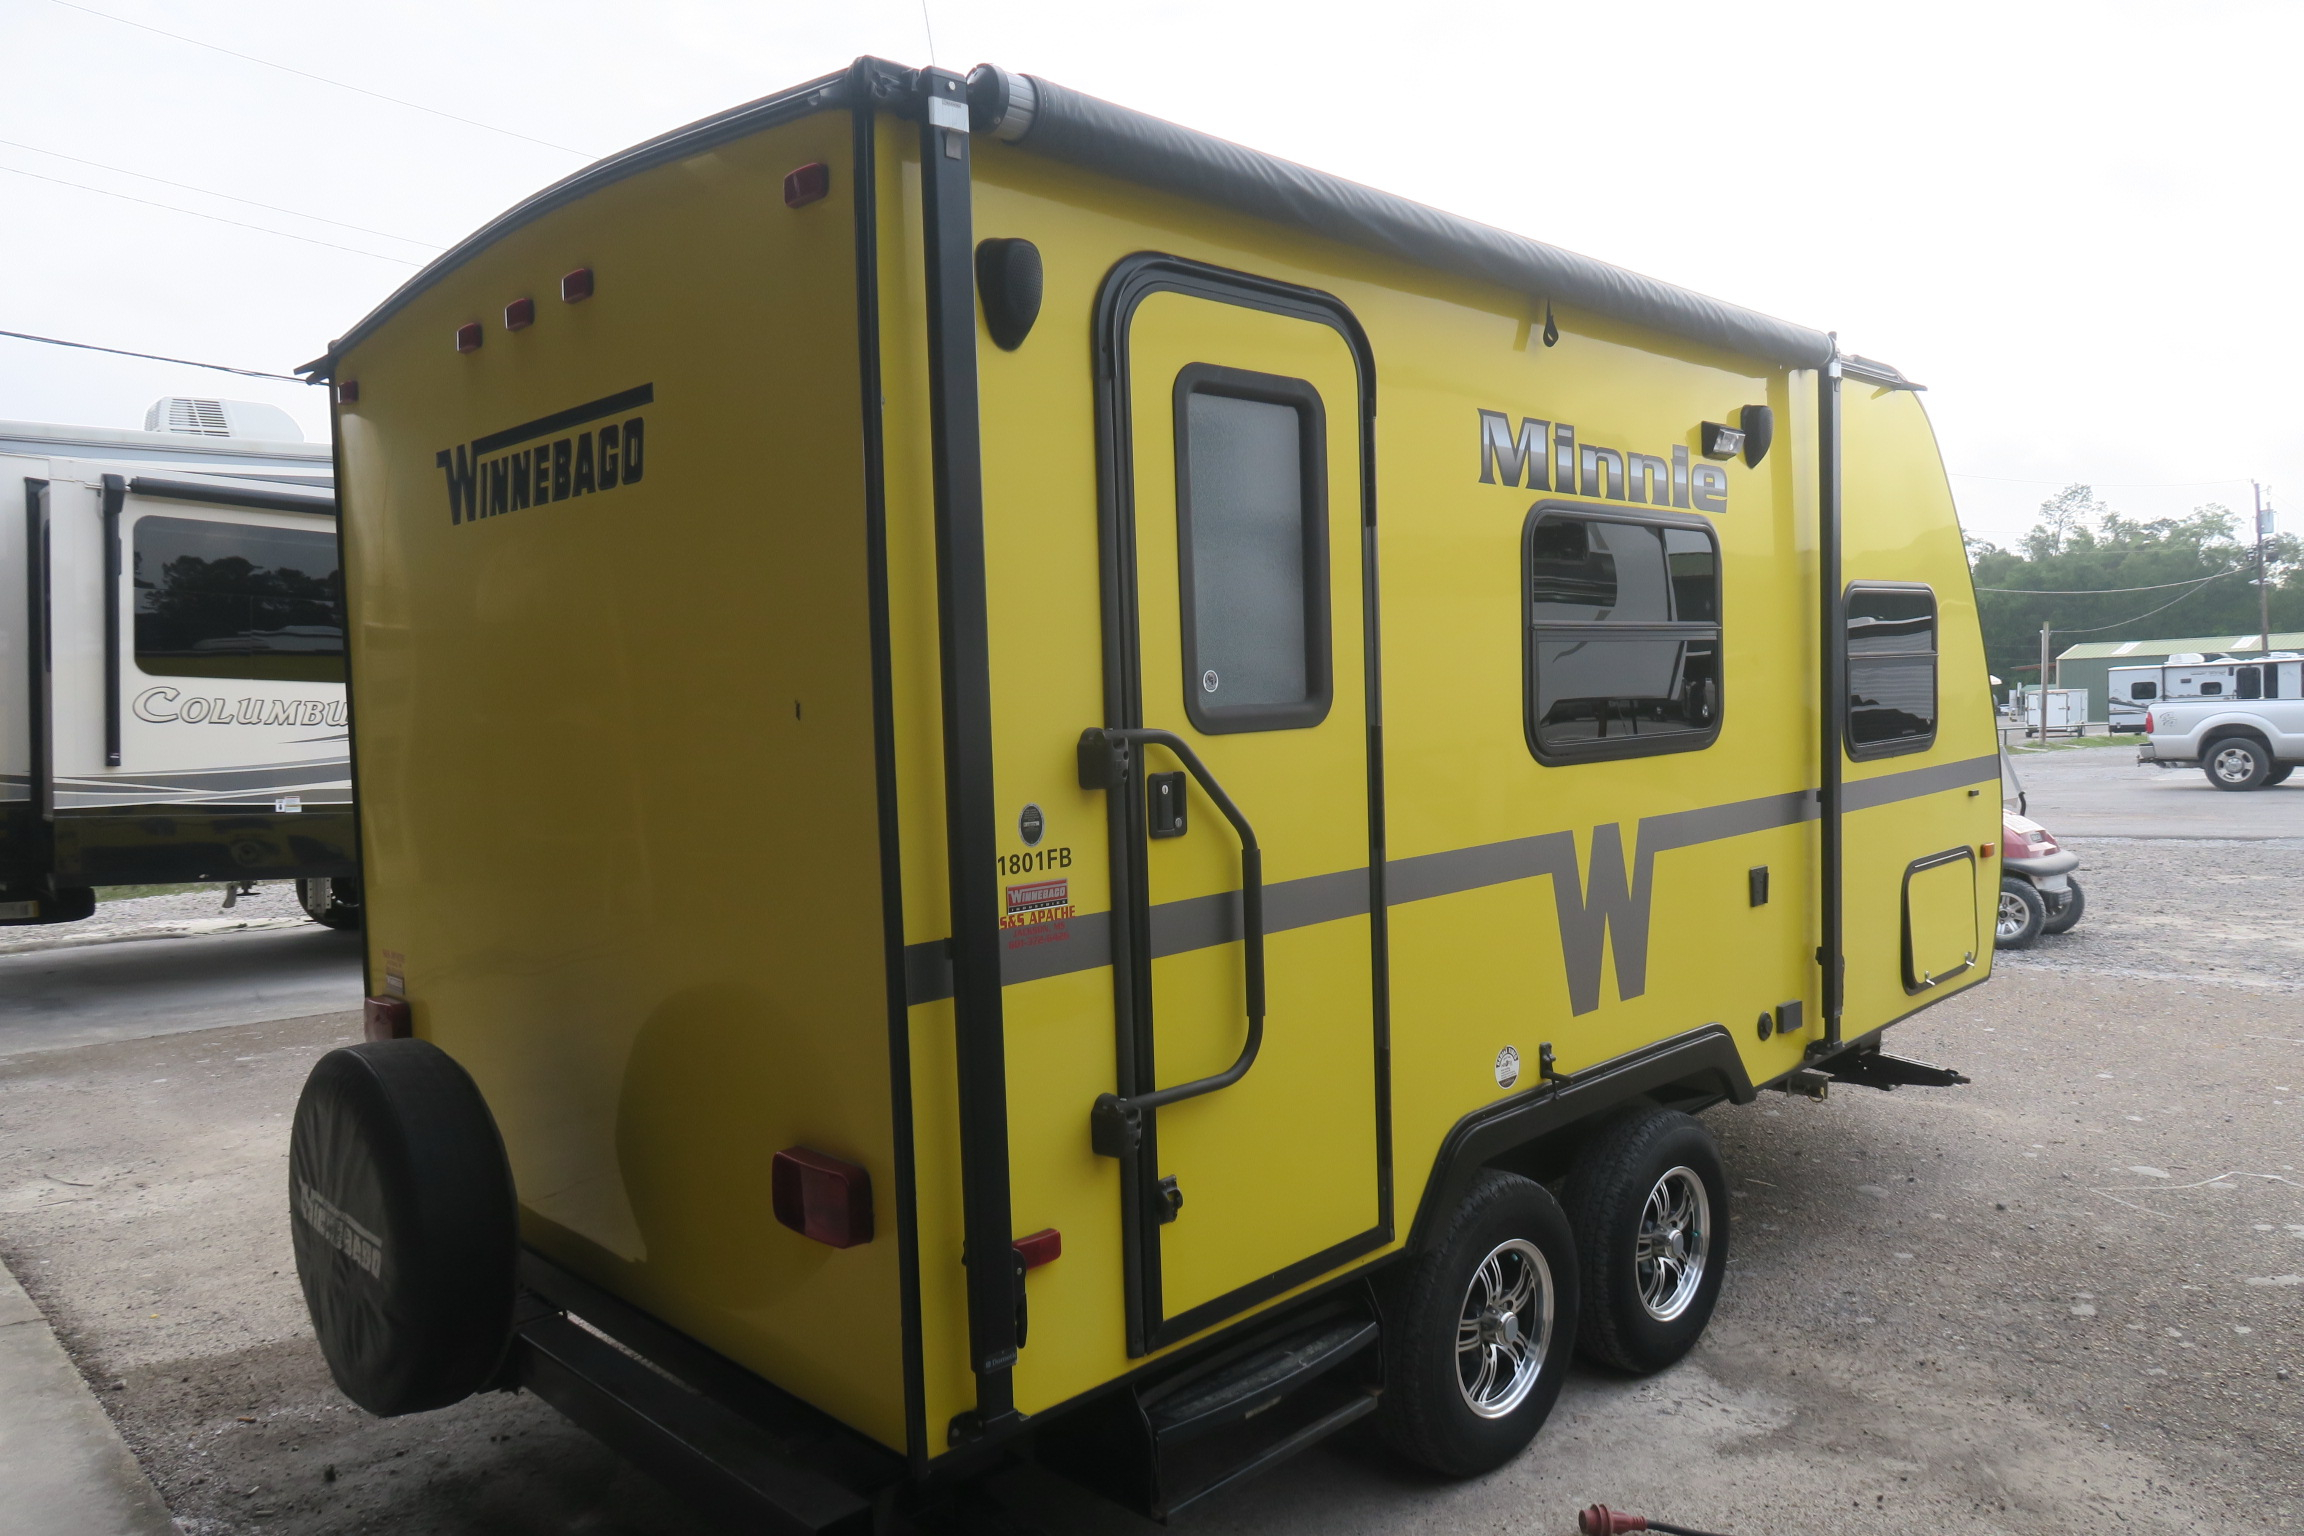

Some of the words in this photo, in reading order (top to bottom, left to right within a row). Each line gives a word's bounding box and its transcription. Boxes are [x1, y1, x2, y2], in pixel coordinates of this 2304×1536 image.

[436, 384, 653, 526] WINNEBAGO
[1477, 408, 1728, 513] Minnie
[997, 847, 1072, 876] 1801FB
[1008, 884, 1067, 904] WINNEBAGO
[999, 912, 1025, 930] S&S
[1029, 905, 1076, 925] APACHE
